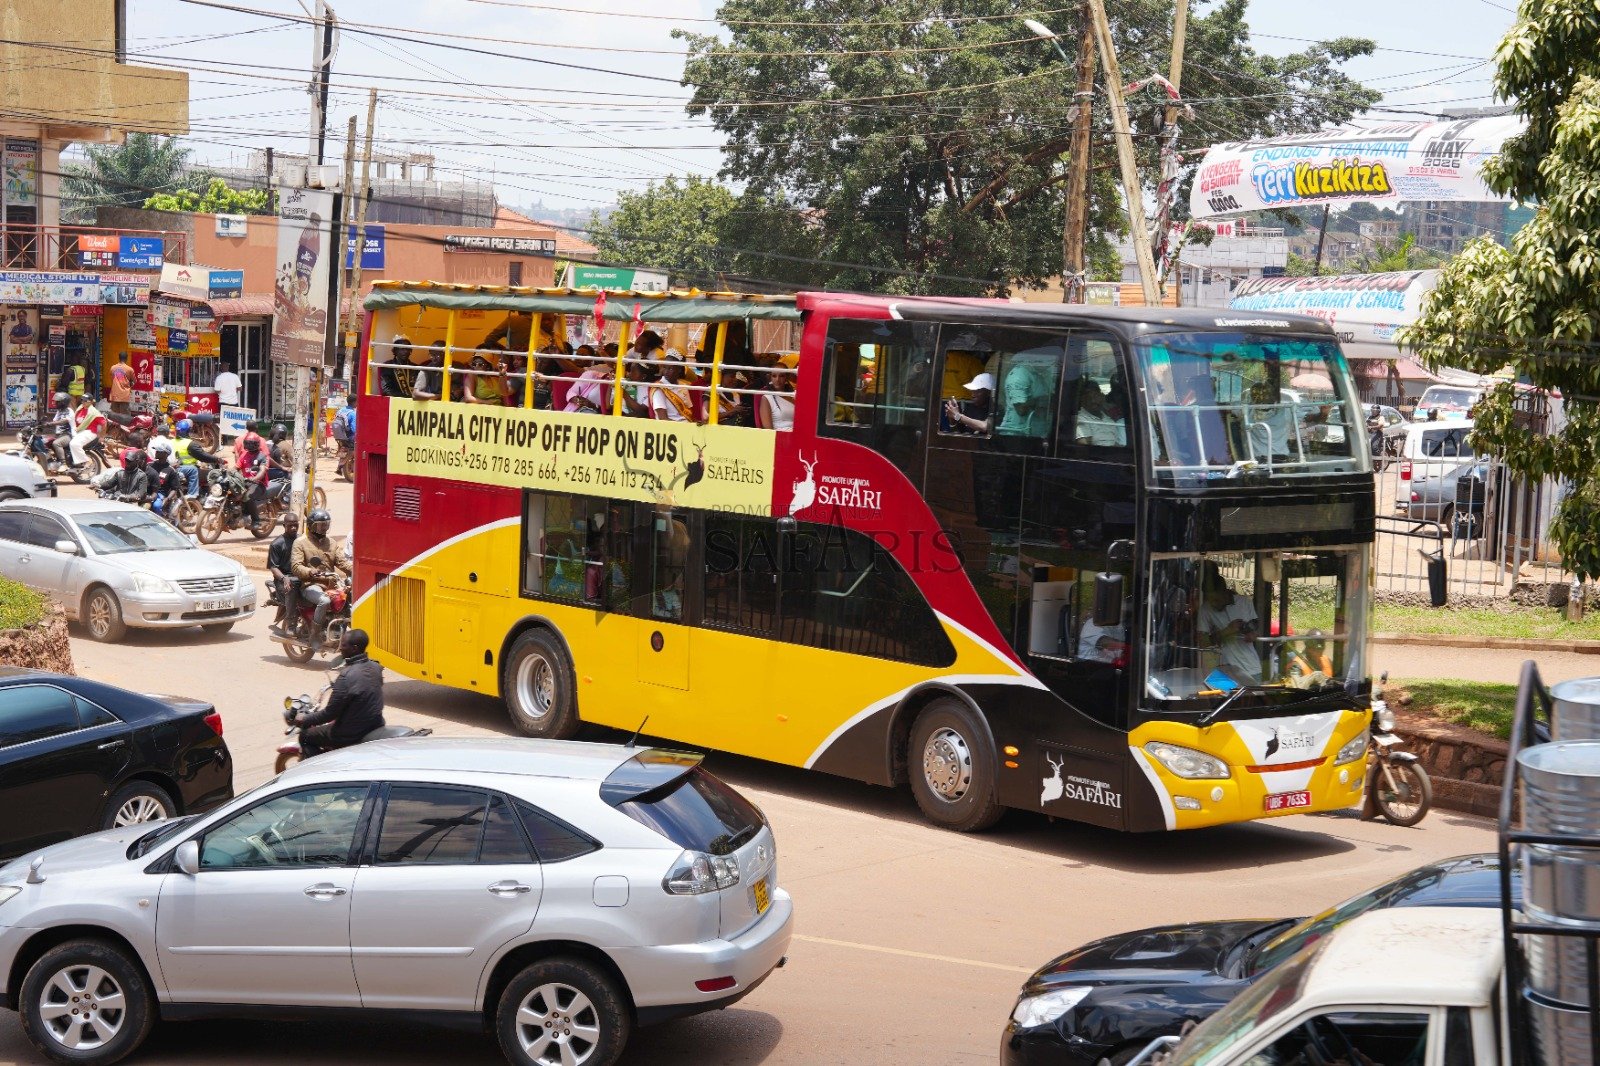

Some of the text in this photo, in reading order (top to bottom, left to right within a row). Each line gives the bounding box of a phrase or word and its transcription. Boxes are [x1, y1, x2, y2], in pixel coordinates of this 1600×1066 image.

[1252, 145, 1321, 163] ENDONGO
[1425, 140, 1467, 159] MAY
[1423, 158, 1461, 168] 2026
[1299, 291, 1353, 309] PRIMARY
[1356, 290, 1406, 312] SCHOOL
[223, 411, 254, 420] PHARMACY
[397, 410, 678, 463] KAMPALA CITY HOP OFF HOP ON BUS
[492, 456, 510, 473] 778
[514, 459, 533, 476] 285
[538, 463, 560, 481] 666,
[564, 466, 591, 483] +256
[595, 468, 616, 486] 704
[621, 470, 637, 488] 113
[641, 473, 663, 491] 234
[708, 459, 764, 484] SAFARIS
[821, 475, 846, 485] PROMOTE
[817, 479, 882, 510] SAFARI
[1281, 732, 1314, 749] SAFARI
[1068, 775, 1090, 784] PROMOTE
[1065, 781, 1122, 808] SAFARI
[1269, 793, 1307, 808] UBF 763S
